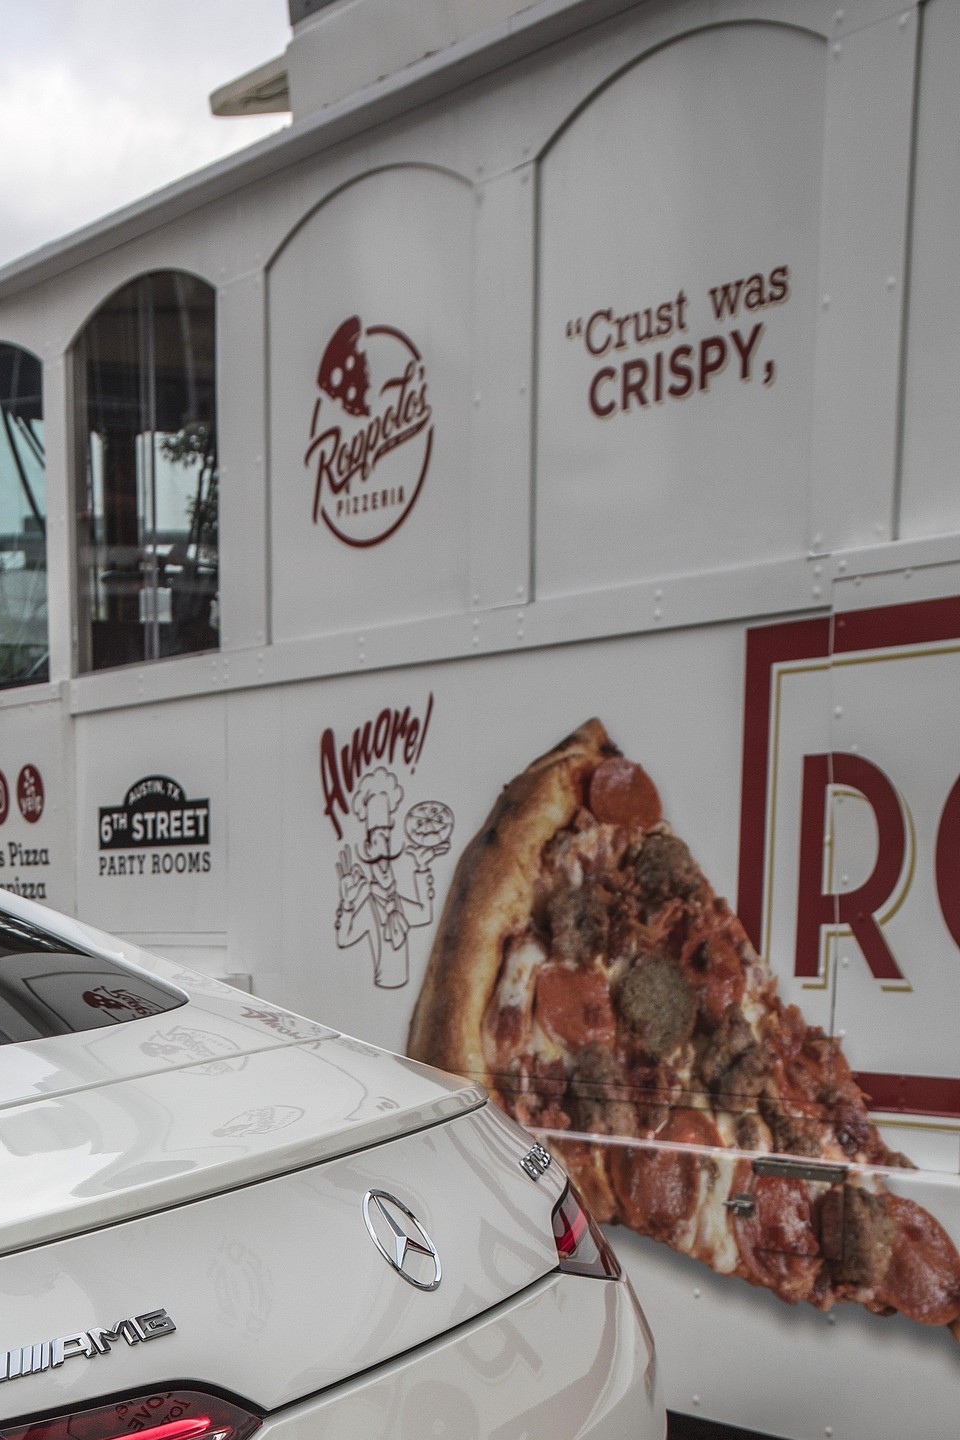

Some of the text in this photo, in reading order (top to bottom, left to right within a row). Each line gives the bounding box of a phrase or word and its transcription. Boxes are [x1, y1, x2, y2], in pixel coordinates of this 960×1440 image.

[709, 264, 790, 321] was
[589, 322, 775, 418] CRISPY,
[336, 485, 406, 517] PIZZERIA
[132, 807, 208, 841] STREET
[7, 841, 50, 868] Pizza
[99, 851, 212, 877] PARTY ROOMS
